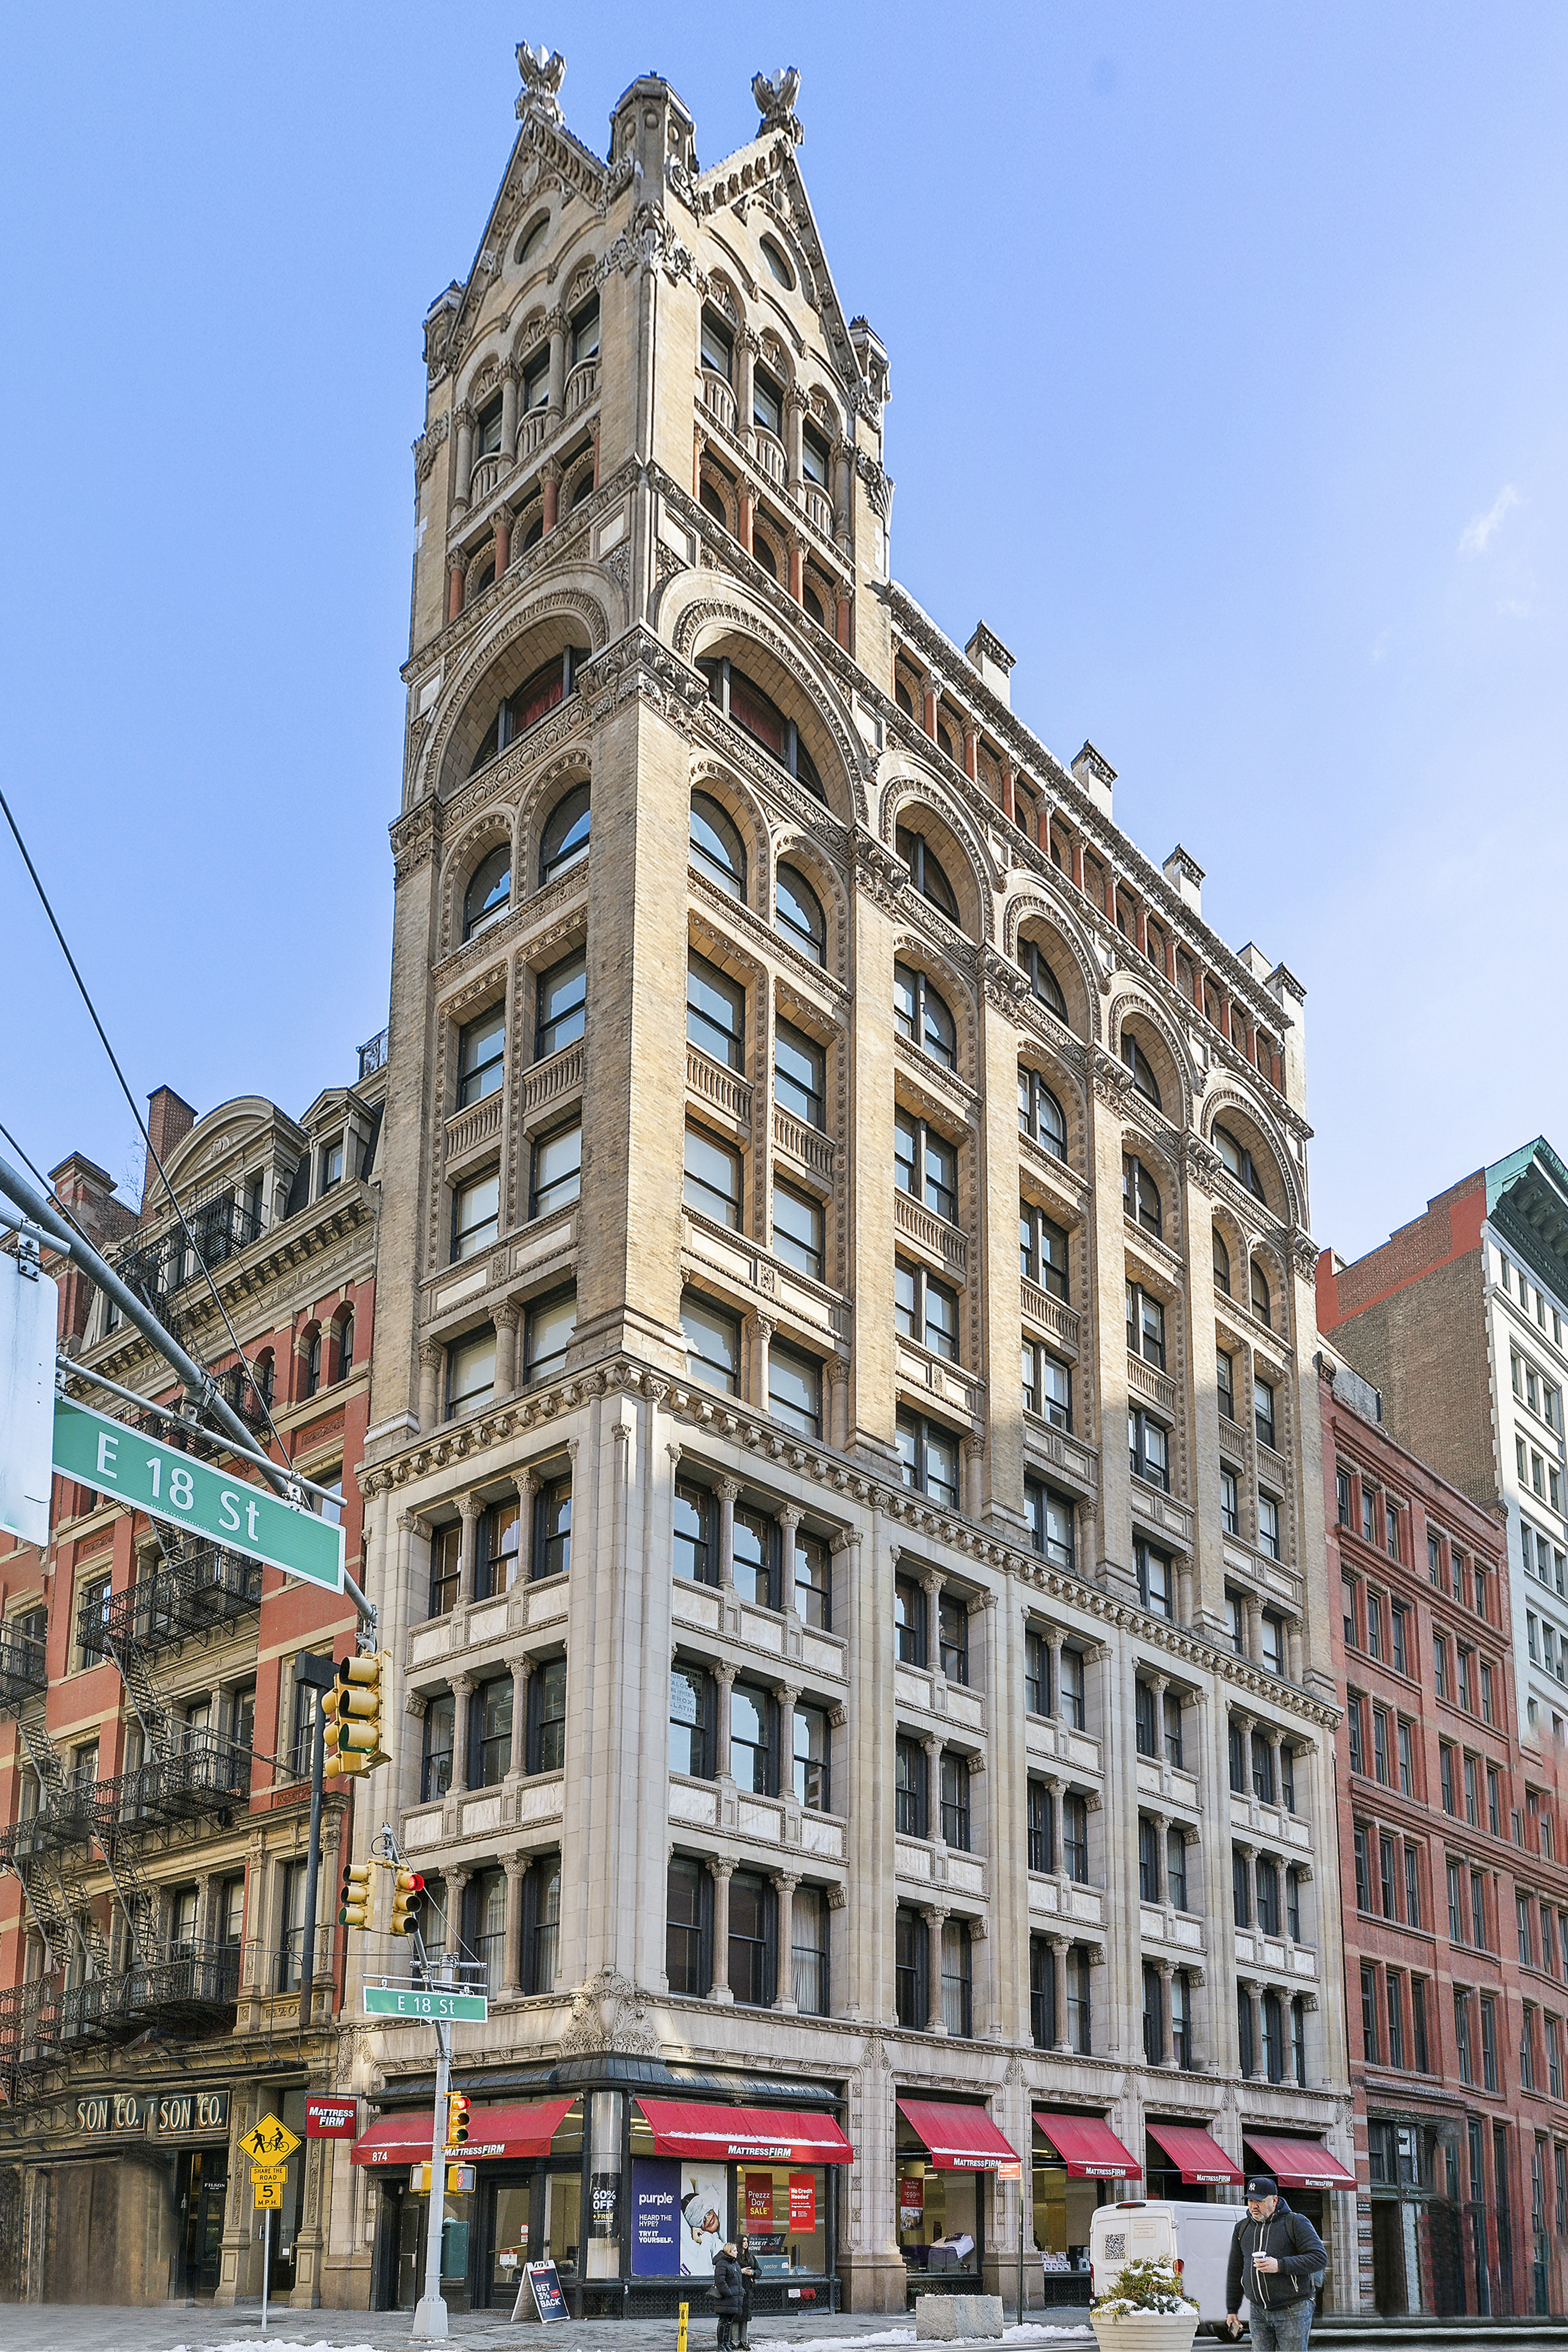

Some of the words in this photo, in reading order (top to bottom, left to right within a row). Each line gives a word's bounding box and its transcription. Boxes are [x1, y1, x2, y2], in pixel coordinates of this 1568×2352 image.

[97, 1431, 119, 1479] E
[146, 1456, 194, 1511] 18
[218, 1490, 260, 1542] St
[170, 1512, 211, 1532] TRANSPORTATION
[670, 1694, 692, 1706] EROX
[398, 1996, 406, 2011] E
[414, 1997, 431, 2013] 18
[439, 1999, 455, 2015] St
[77, 2100, 108, 2130] SON
[117, 2097, 139, 2127] CO.
[159, 2099, 191, 2130] SON
[199, 2096, 222, 2126] CO.
[308, 2107, 354, 2118] MATTRESS
[319, 2116, 345, 2126] FIRM
[372, 2151, 388, 2162] 874
[262, 2185, 274, 2197] 5
[593, 2190, 616, 2200] 60%
[639, 2192, 673, 2205] purple
[751, 2199, 765, 2207] Day
[593, 2200, 613, 2210] OFF
[535, 2283, 550, 2292] GET
[539, 2297, 561, 2308] BACK
